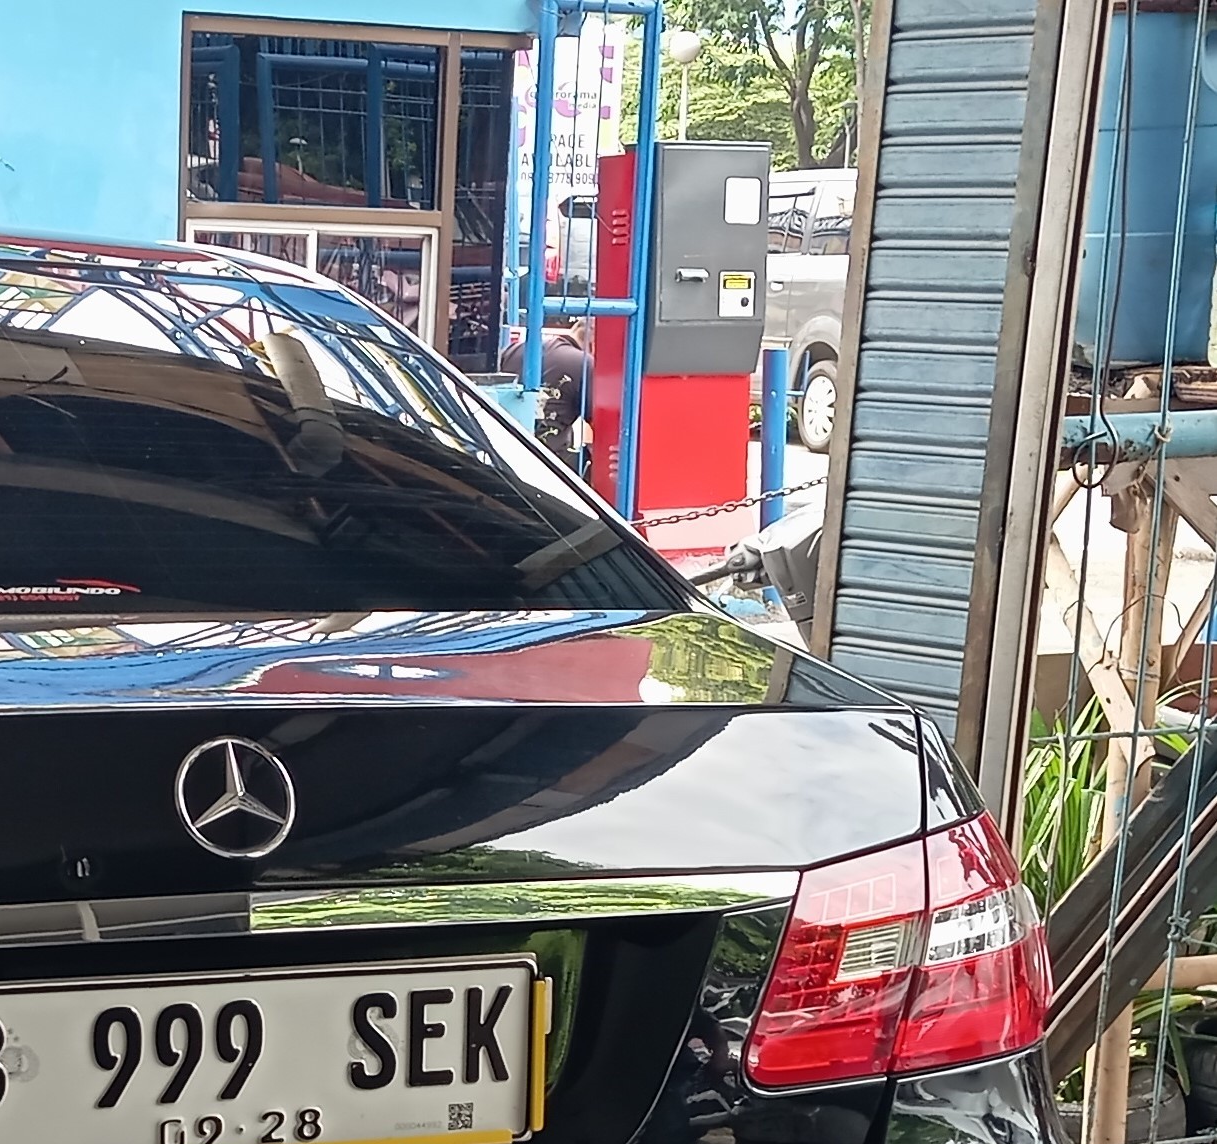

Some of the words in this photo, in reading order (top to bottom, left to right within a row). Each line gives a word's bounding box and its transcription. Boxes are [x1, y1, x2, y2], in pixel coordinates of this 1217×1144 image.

[549, 134, 586, 148] ACE
[522, 153, 596, 168] AILABL
[92, 998, 264, 1108] 999
[349, 984, 515, 1090] SEK
